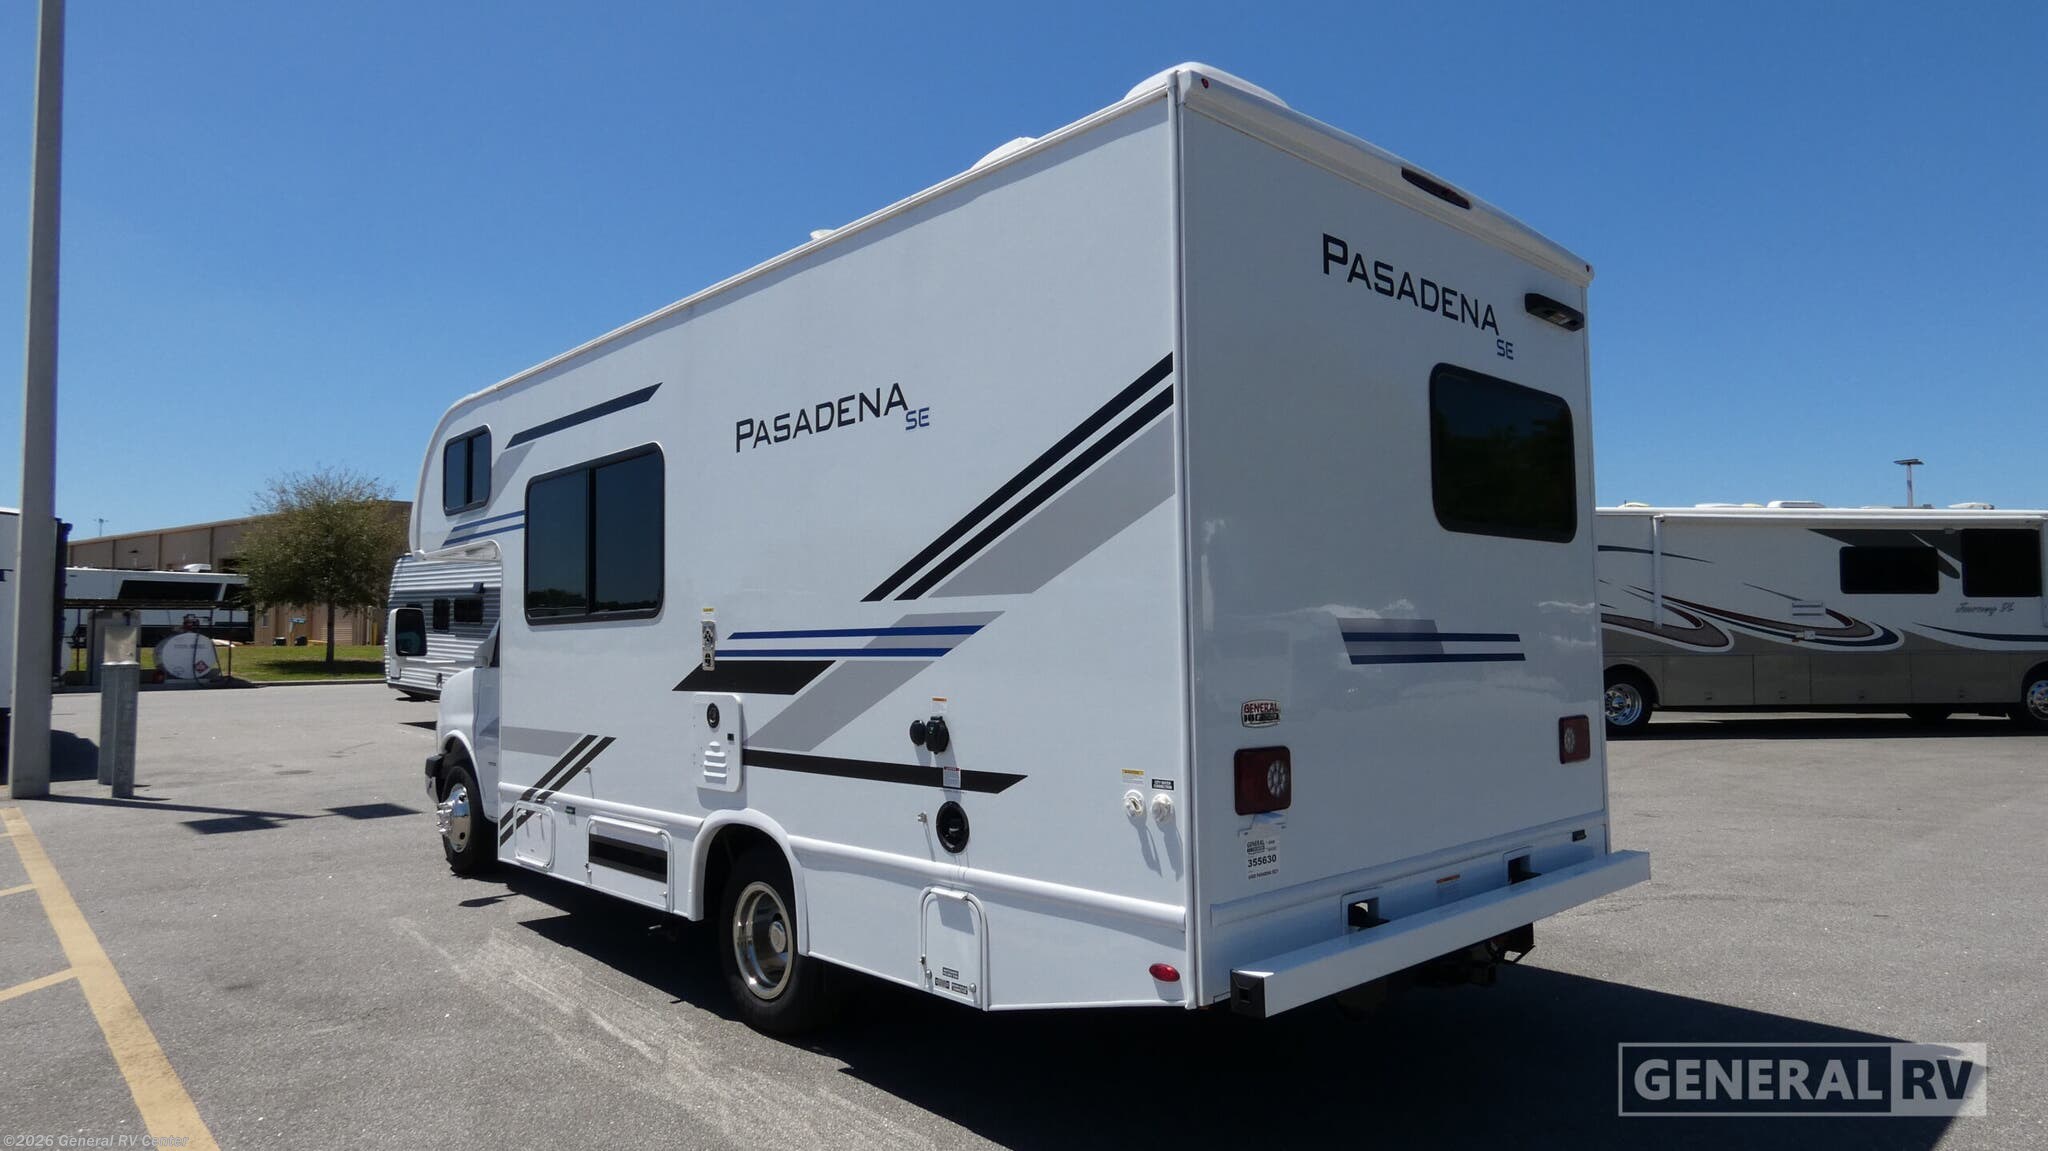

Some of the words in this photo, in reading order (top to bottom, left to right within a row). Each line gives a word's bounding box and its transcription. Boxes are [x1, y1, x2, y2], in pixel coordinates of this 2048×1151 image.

[1323, 233, 1499, 335] PASADENA
[1496, 339, 1514, 360] SE
[736, 382, 908, 453] PASADENA
[905, 407, 930, 430] SE
[1244, 702, 1279, 713] GENERAL
[1247, 854, 1277, 868] 355630
